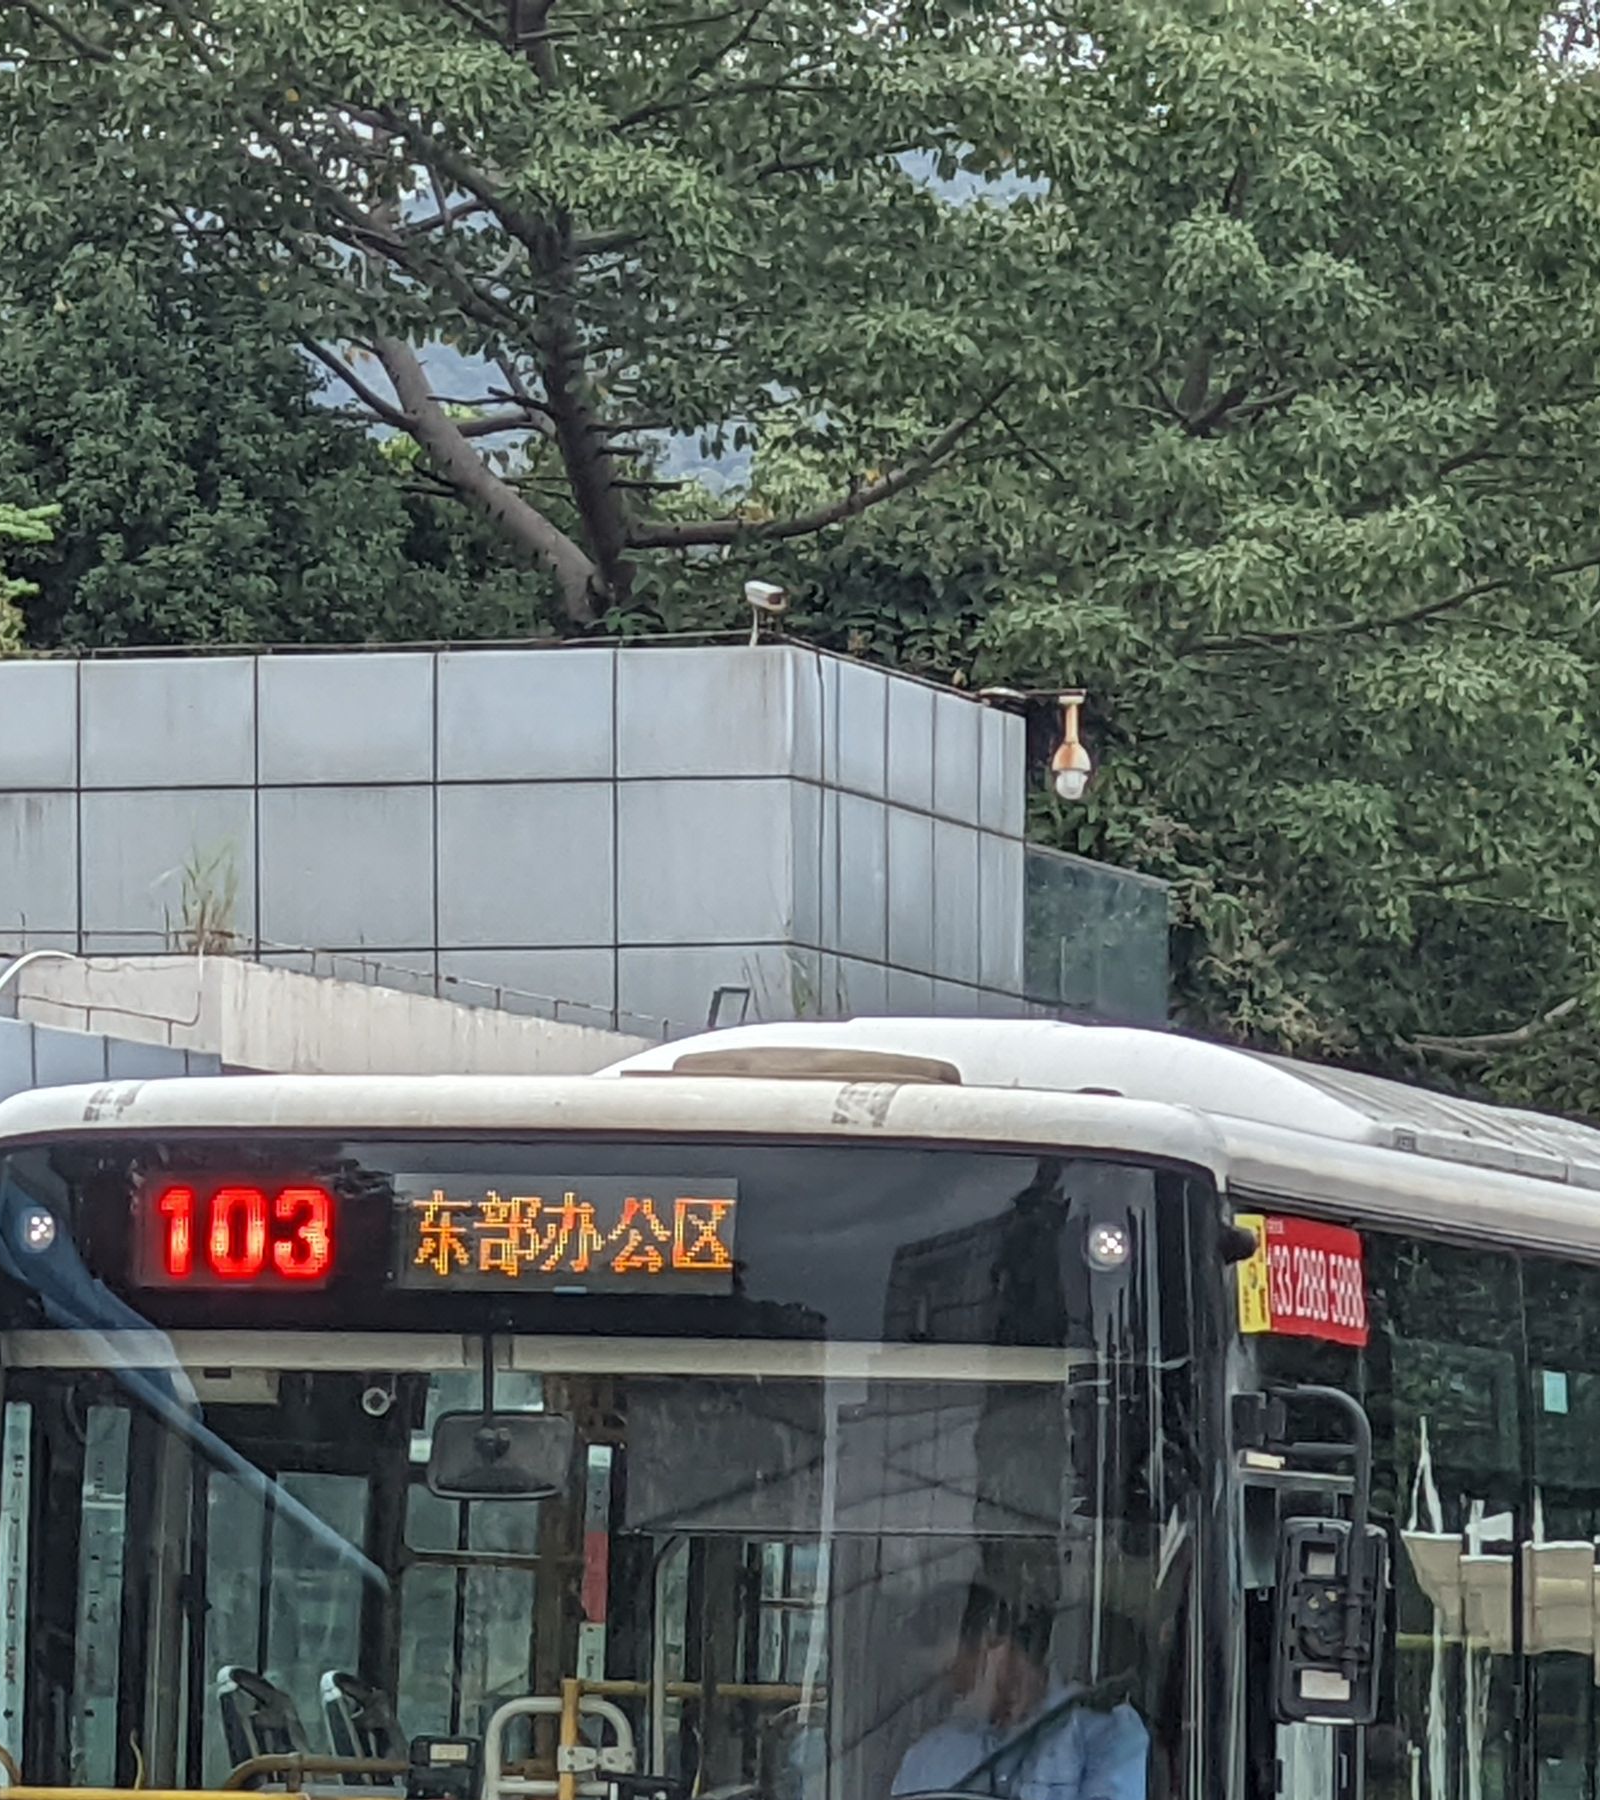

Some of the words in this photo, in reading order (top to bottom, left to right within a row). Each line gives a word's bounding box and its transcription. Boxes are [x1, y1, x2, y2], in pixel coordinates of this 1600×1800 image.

[159, 1186, 330, 1277] 103
[411, 1189, 736, 1277] 东部办公区
